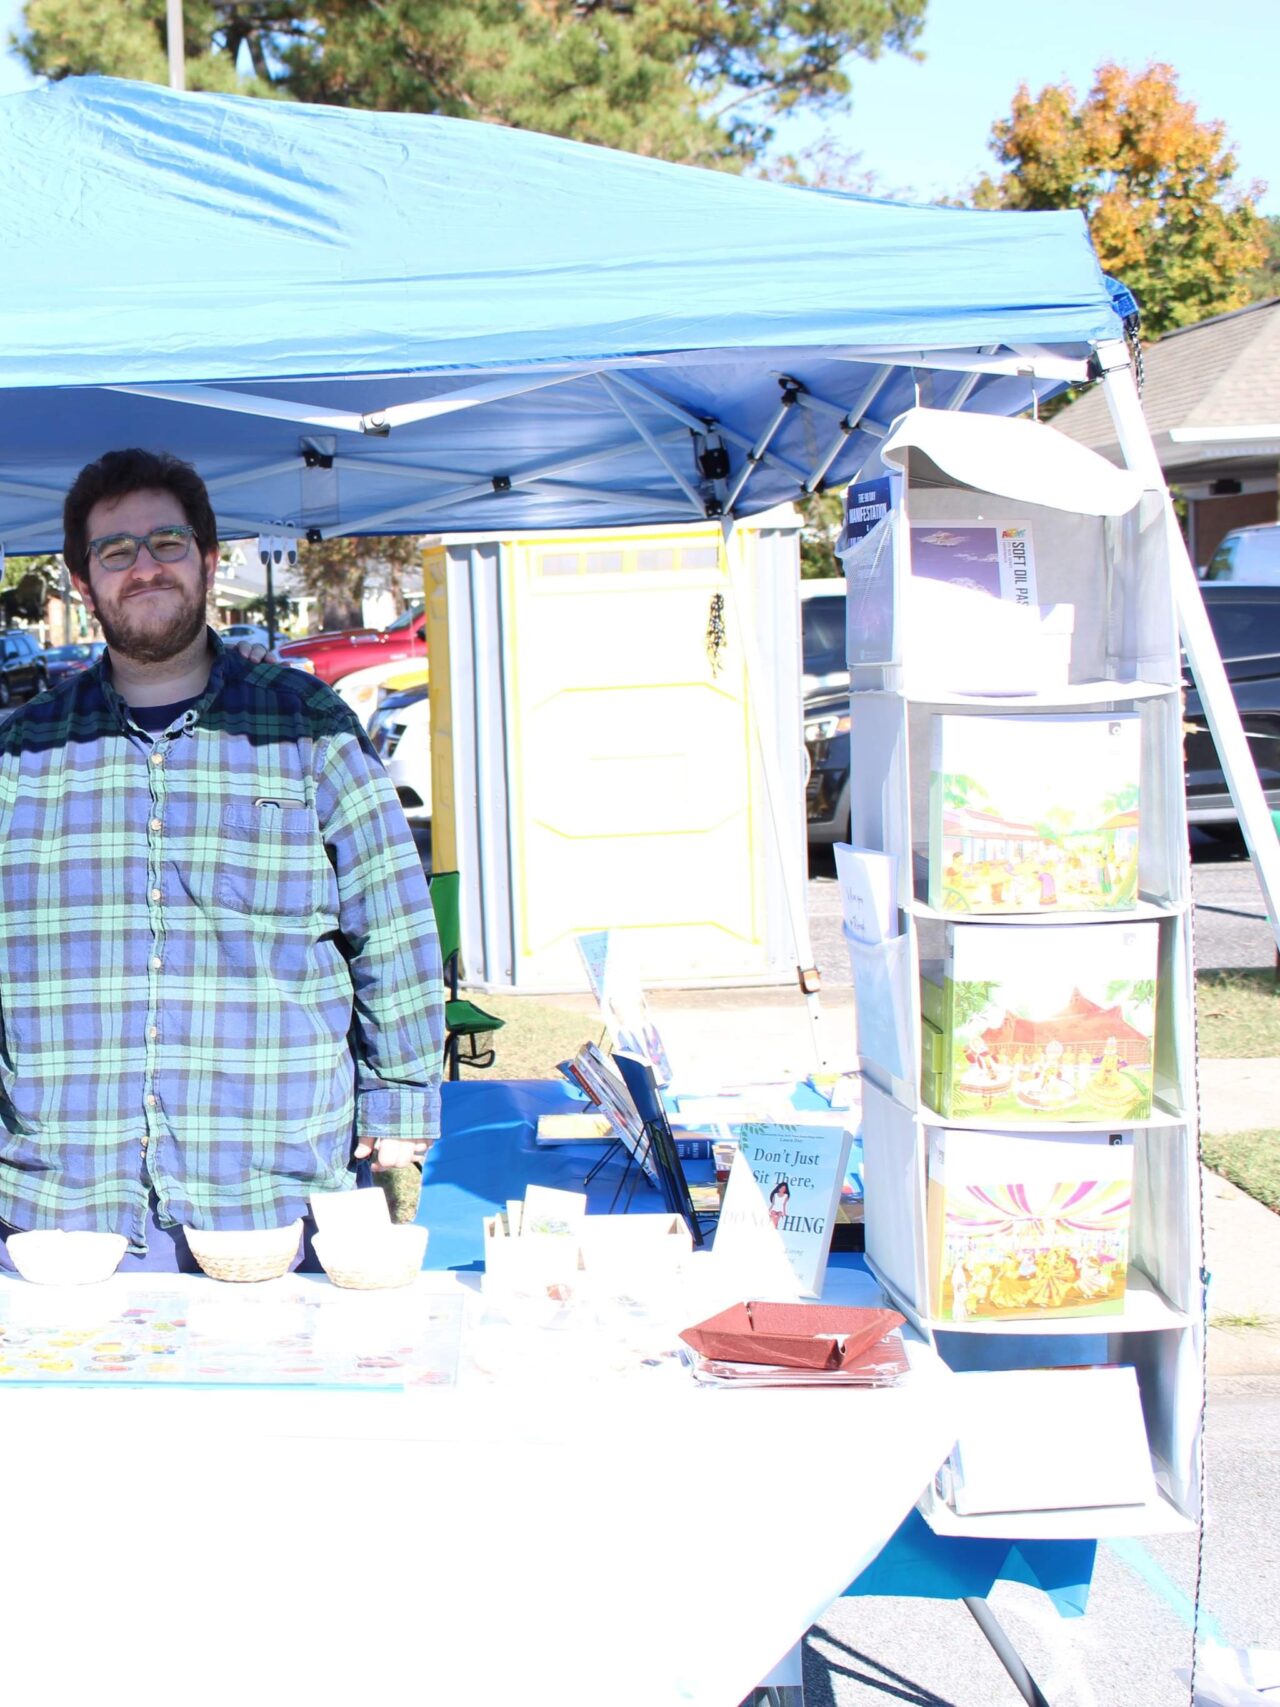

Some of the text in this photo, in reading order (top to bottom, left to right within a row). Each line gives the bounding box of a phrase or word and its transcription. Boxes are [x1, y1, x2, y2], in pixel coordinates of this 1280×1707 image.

[1012, 541, 1026, 567] SOFT
[1014, 570, 1027, 585] OIL
[753, 1147, 820, 1167] Don't Just
[752, 1169, 815, 1190] Sit There,
